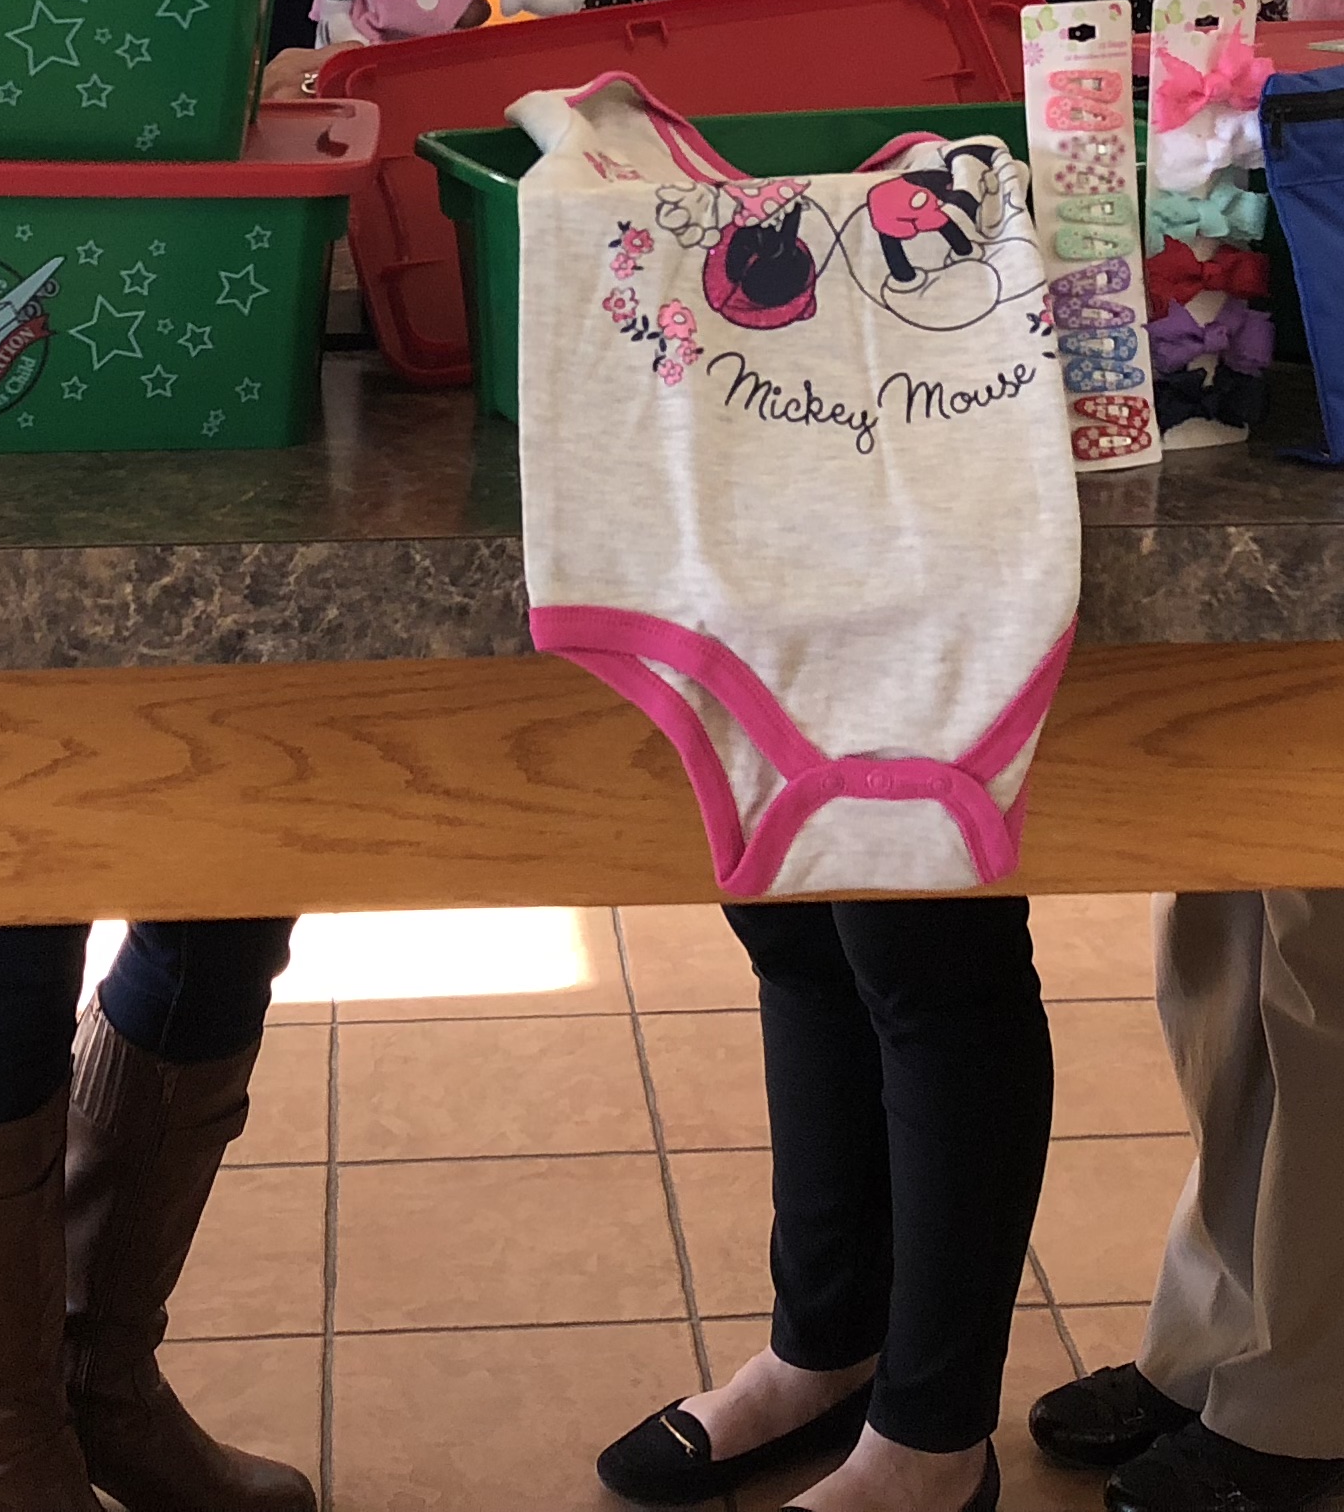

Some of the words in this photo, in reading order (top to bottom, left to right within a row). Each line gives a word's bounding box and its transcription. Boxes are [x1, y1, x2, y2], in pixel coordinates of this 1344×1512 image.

[5, 356, 38, 395] Child
[706, 351, 879, 455] Mickey
[877, 363, 1037, 424] Mouse
